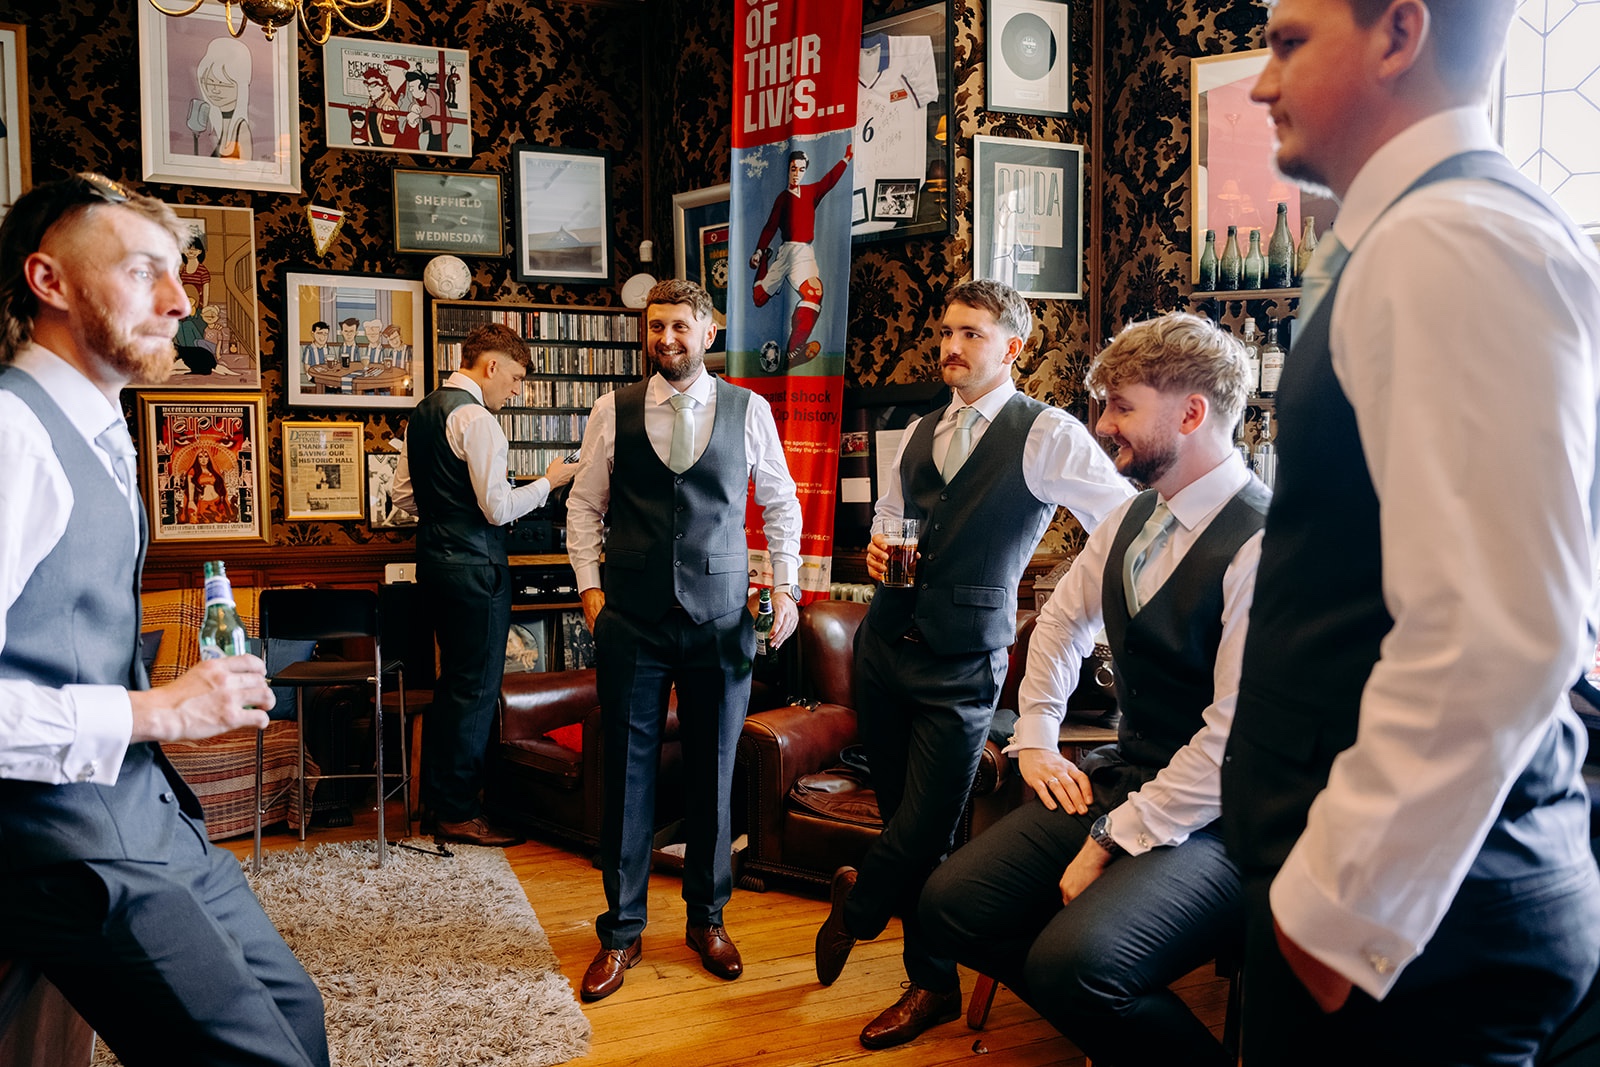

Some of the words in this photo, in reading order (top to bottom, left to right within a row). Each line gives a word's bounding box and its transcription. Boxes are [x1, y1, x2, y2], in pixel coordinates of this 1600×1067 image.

[746, 2, 778, 48] OF
[744, 33, 821, 90] THEIR
[744, 79, 845, 133] LIVES...
[862, 116, 874, 142] 6
[415, 195, 482, 208] SHEFFIELD
[431, 214, 439, 224] F
[460, 216, 468, 225] C
[415, 231, 485, 244] WEDNESDAY
[791, 390, 831, 403] shock
